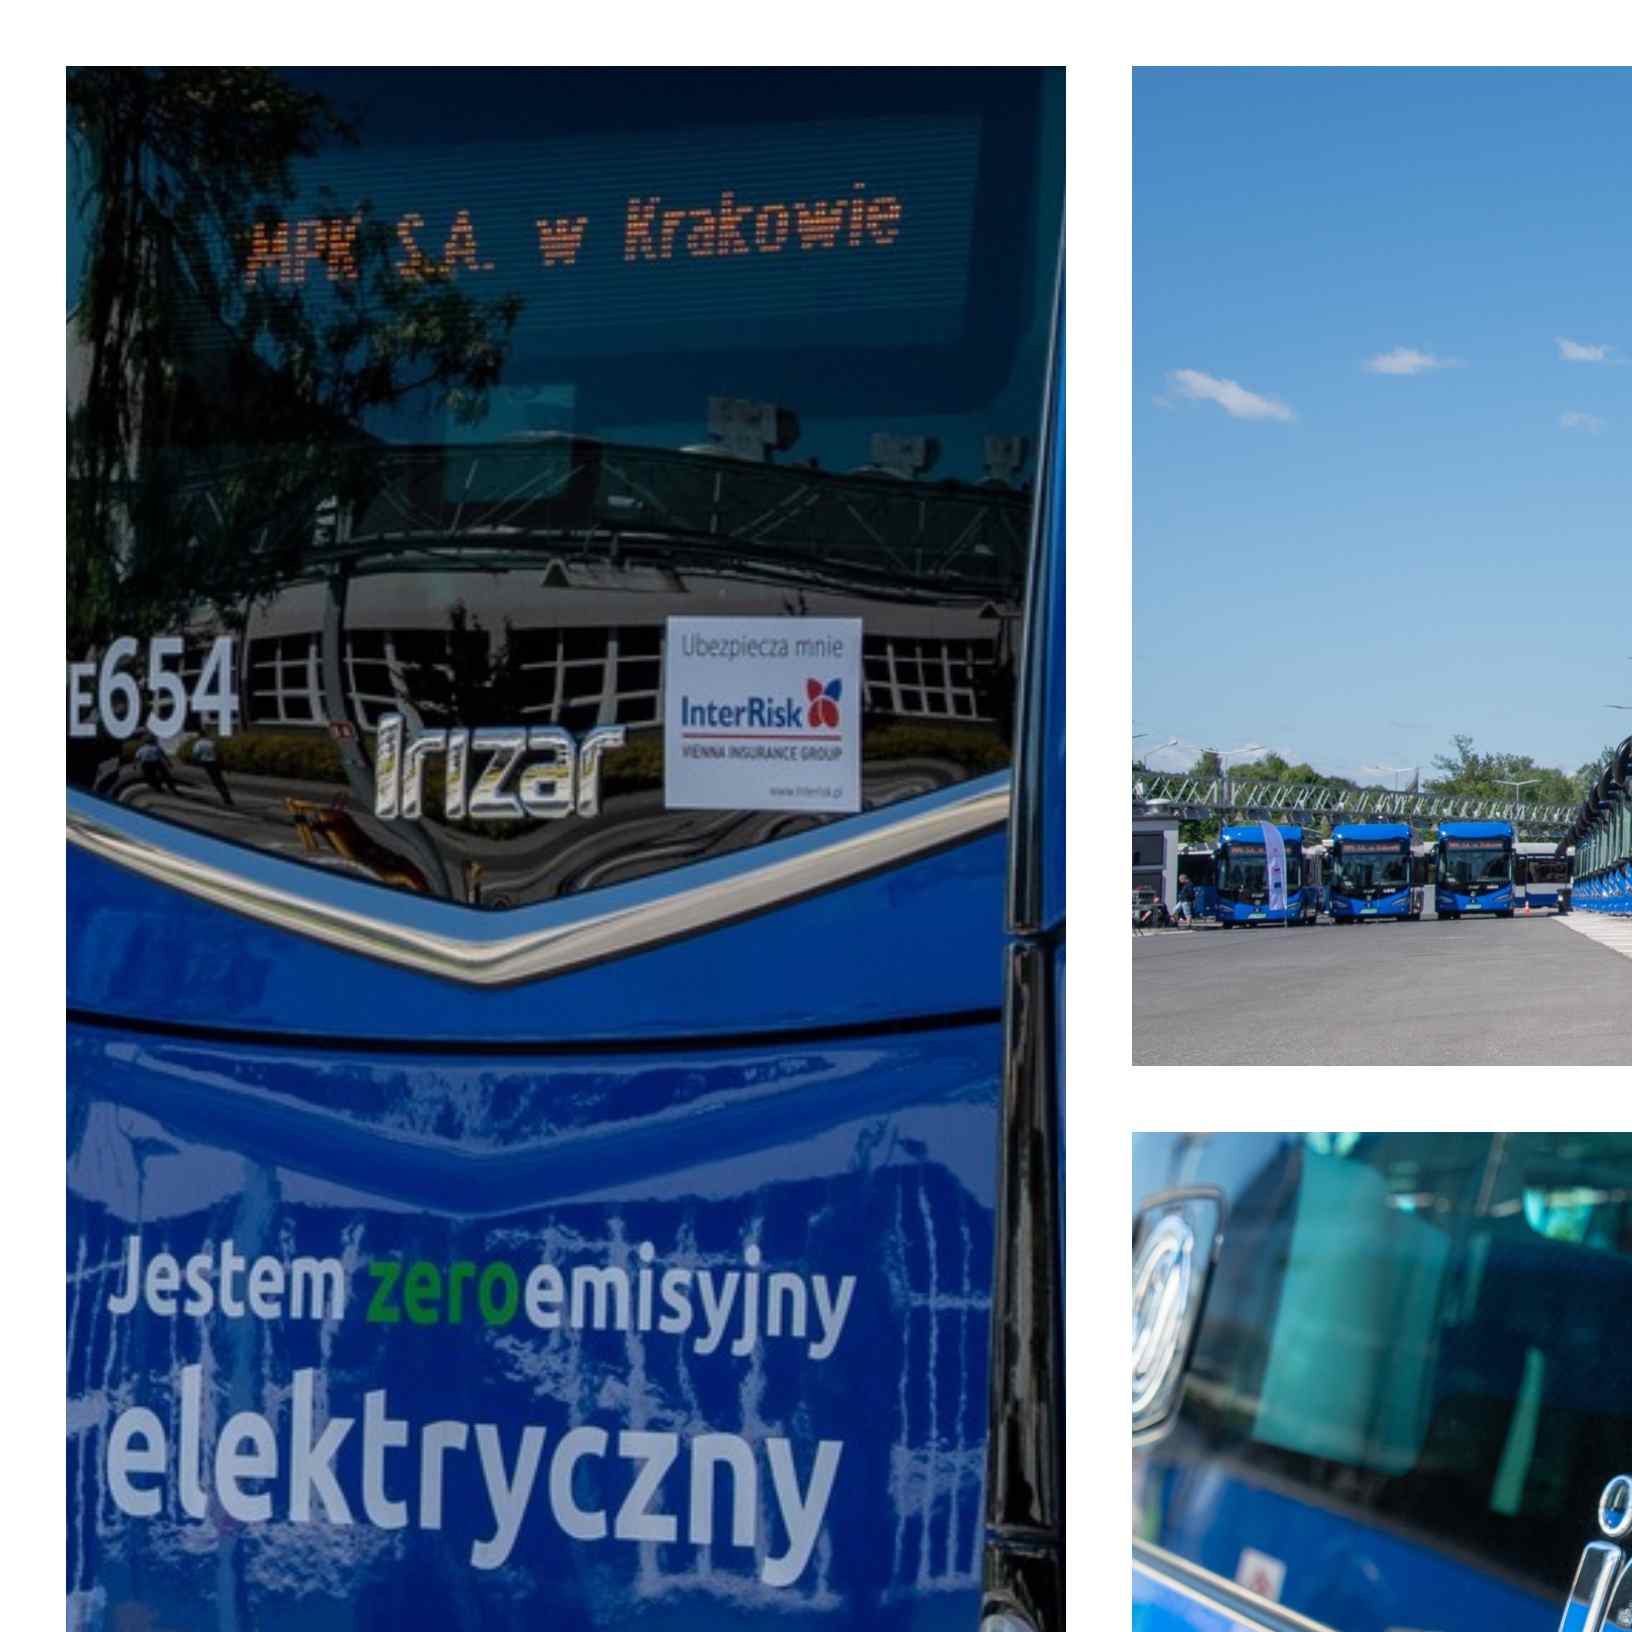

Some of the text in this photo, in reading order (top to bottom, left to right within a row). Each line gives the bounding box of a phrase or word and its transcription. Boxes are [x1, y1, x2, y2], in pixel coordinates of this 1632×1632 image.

[244, 214, 363, 287] MPK
[536, 216, 589, 267] w
[623, 181, 902, 262] Krakowie
[68, 634, 240, 740] E654
[681, 632, 844, 662] Ubezpiecza mnie
[681, 695, 804, 729] InterRisk
[681, 743, 844, 762] VIENNA INSURANCE GROUP
[106, 1235, 857, 1360] Jestem zeroemisyjny
[106, 1363, 844, 1587] elektryczny
